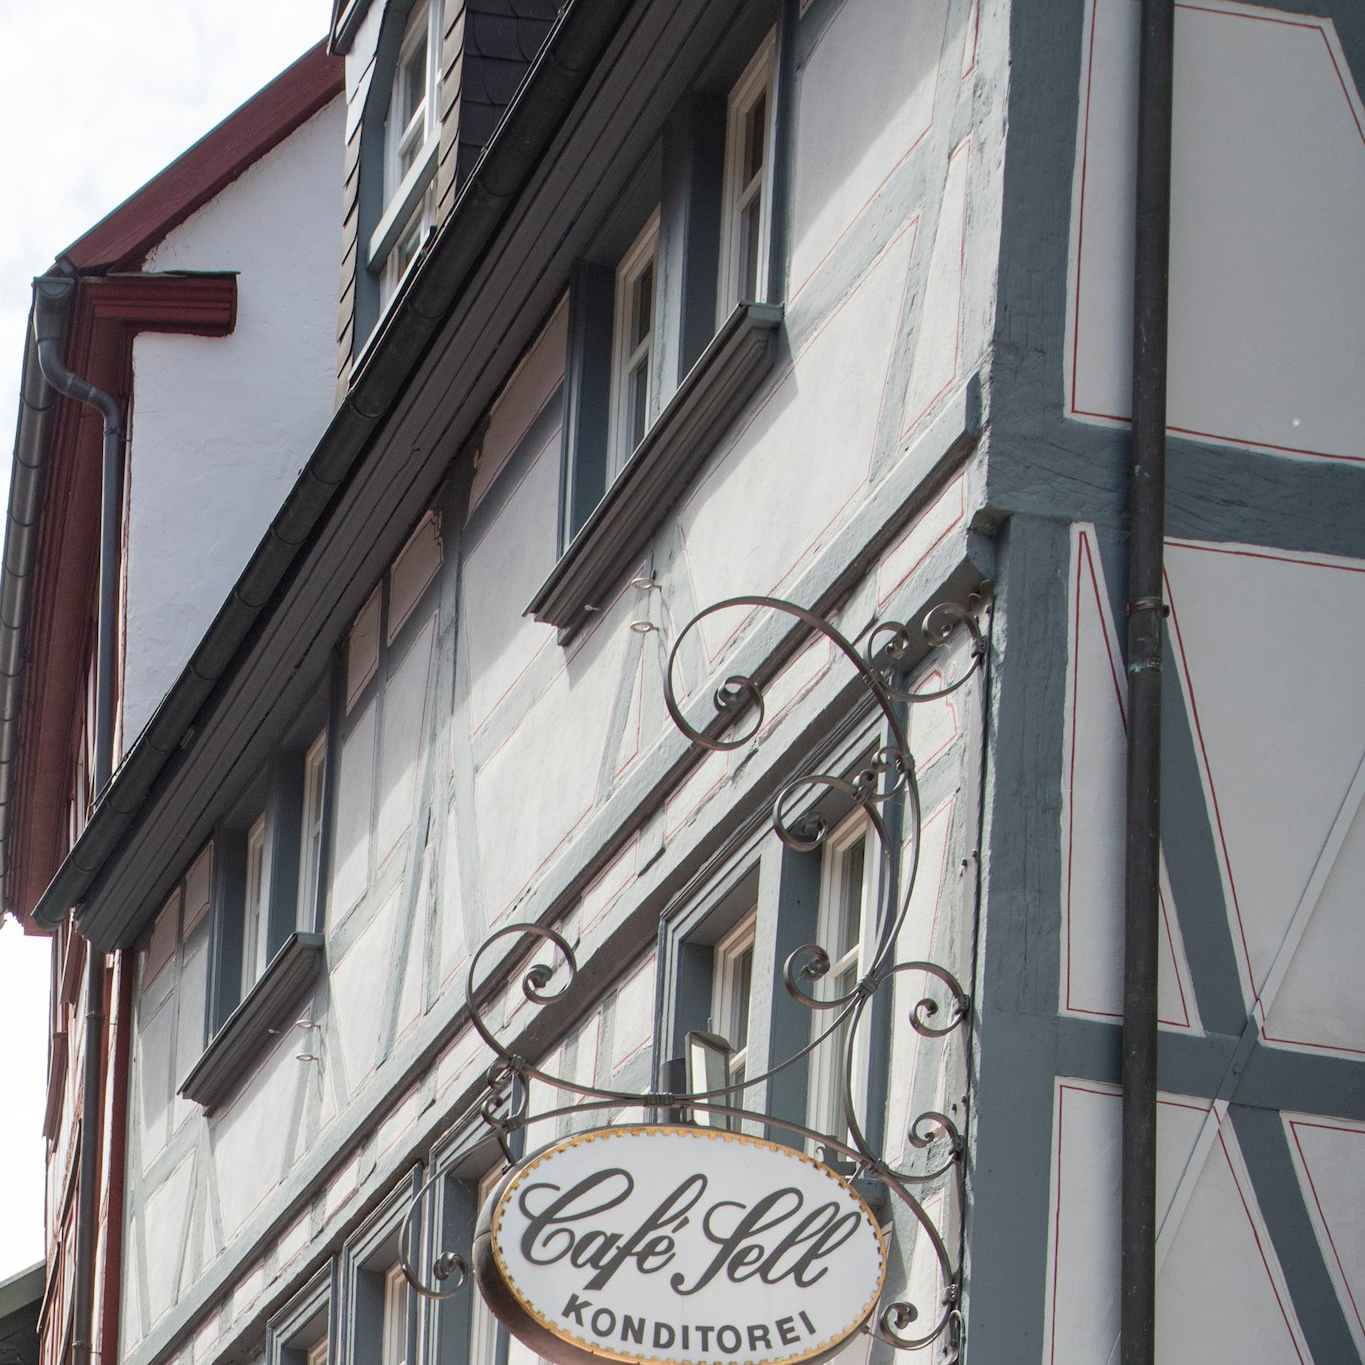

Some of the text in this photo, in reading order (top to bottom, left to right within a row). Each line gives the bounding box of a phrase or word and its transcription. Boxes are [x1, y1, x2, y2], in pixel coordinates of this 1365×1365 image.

[518, 1166, 863, 1296] Café Sell
[562, 1293, 817, 1354] KONDITOREI
